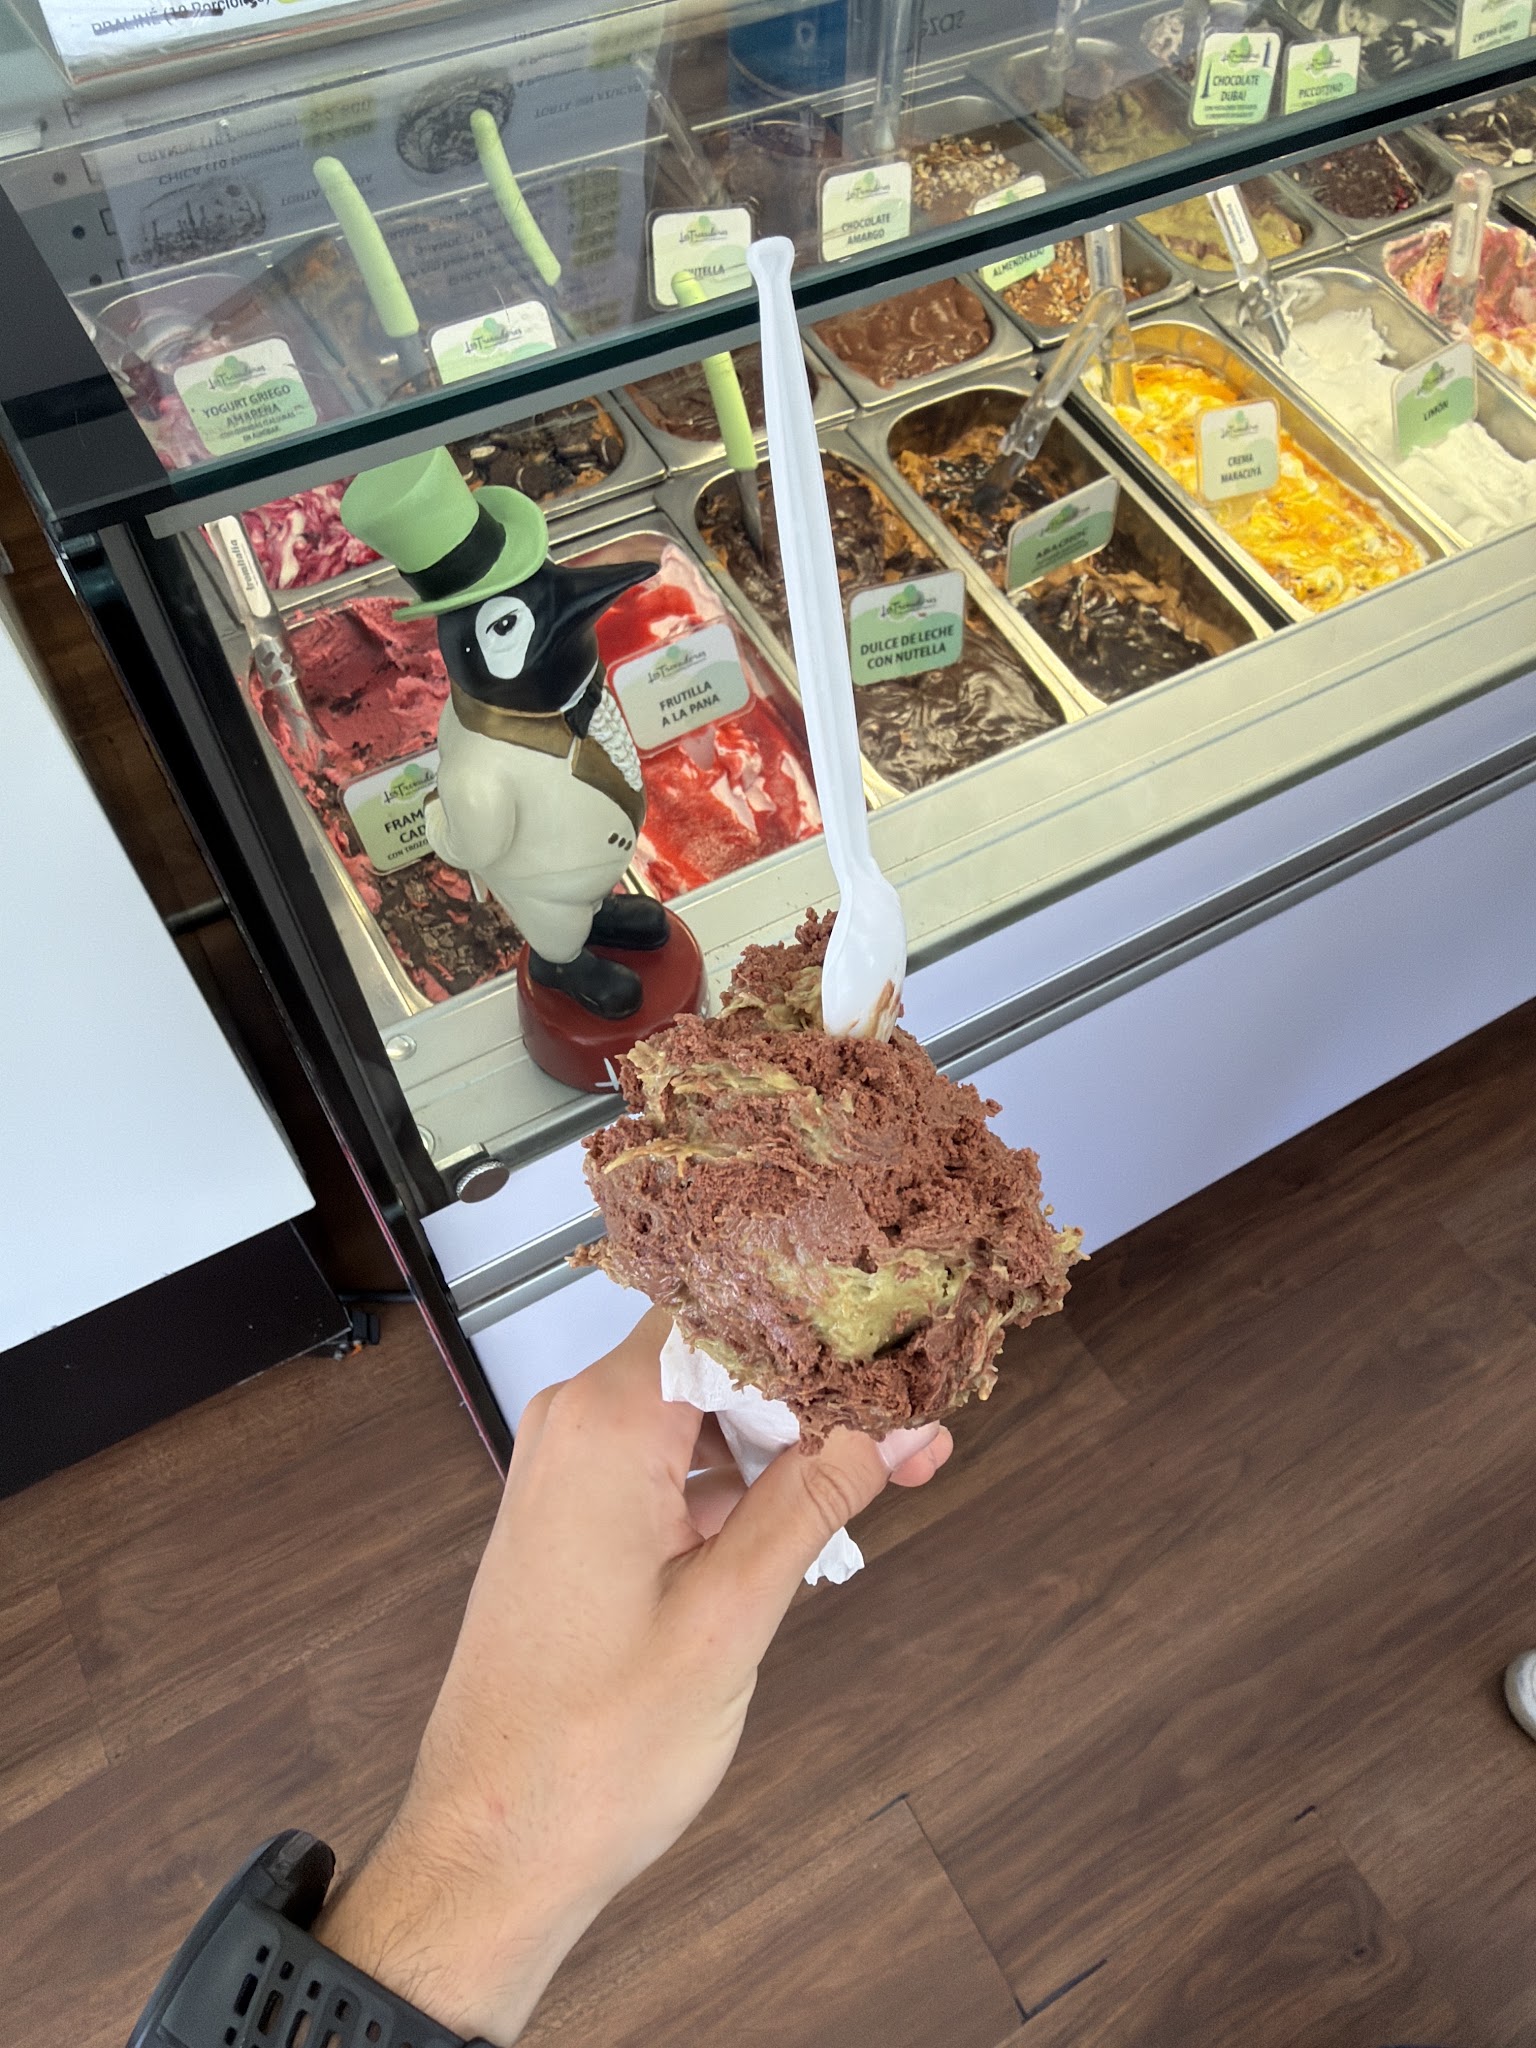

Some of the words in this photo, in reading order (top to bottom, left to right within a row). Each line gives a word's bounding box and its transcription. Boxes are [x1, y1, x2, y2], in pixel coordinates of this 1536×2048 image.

[1213, 75, 1260, 86] CHOCOLATE
[1221, 90, 1247, 101] DUBAI
[841, 213, 890, 232] CHOCOLATE
[847, 229, 885, 244] AMARGO
[202, 397, 248, 419] YOGURT
[250, 384, 291, 404] GRIEGO
[1228, 453, 1254, 467] CREMA
[860, 636, 898, 656] DULCE
[901, 633, 916, 647] DE
[918, 624, 954, 643] LECHE
[867, 655, 893, 670] CON
[895, 642, 946, 662] NUTELLA
[659, 681, 712, 712] FRUTILLA
[662, 716, 671, 728] A
[672, 708, 688, 722] LA
[689, 693, 721, 714] PANA
[387, 849, 404, 861] CON
